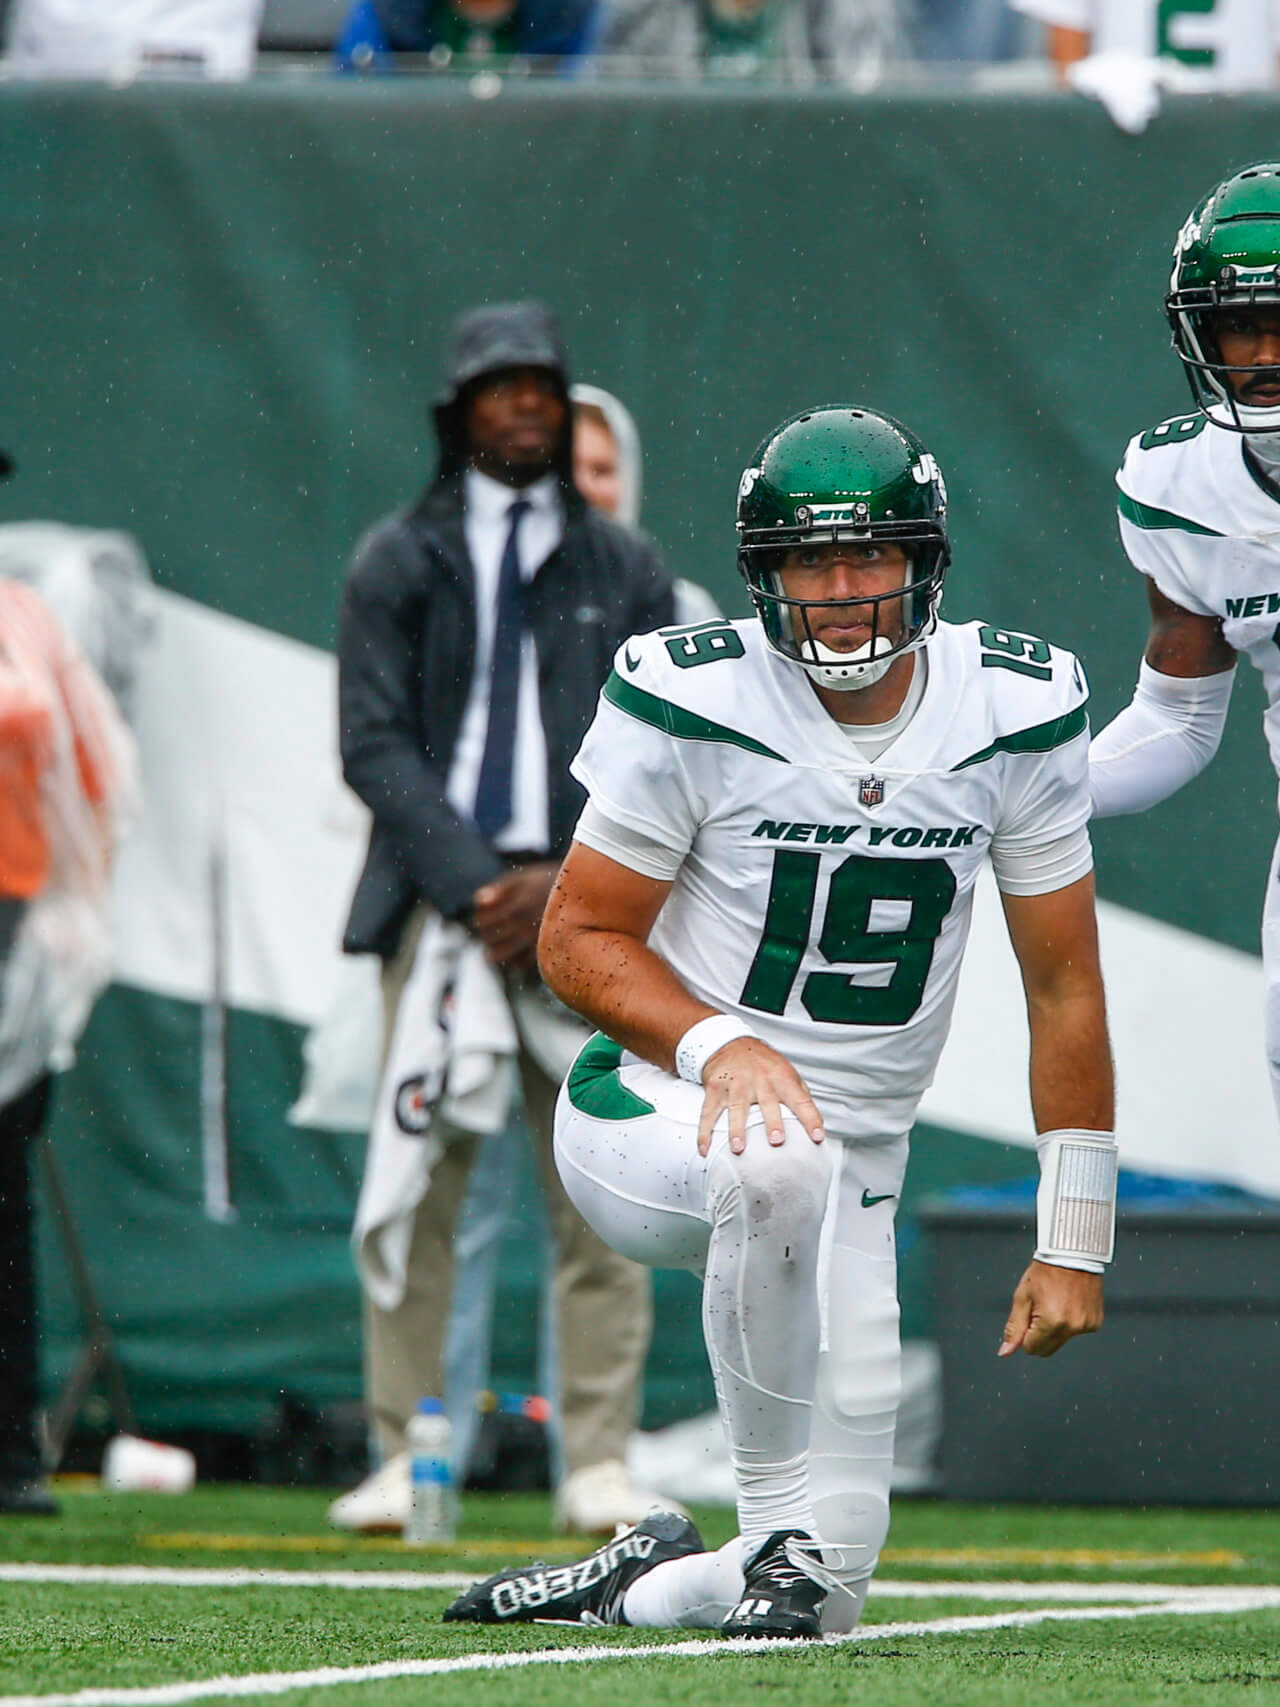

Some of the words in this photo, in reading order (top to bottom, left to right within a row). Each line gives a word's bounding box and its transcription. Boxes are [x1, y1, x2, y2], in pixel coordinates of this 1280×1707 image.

[1139, 410, 1209, 451] 8
[658, 619, 746, 669] 19
[978, 624, 1053, 682] 19
[751, 819, 863, 844] NEW
[867, 823, 984, 848] YORK
[738, 848, 957, 1027] 19
